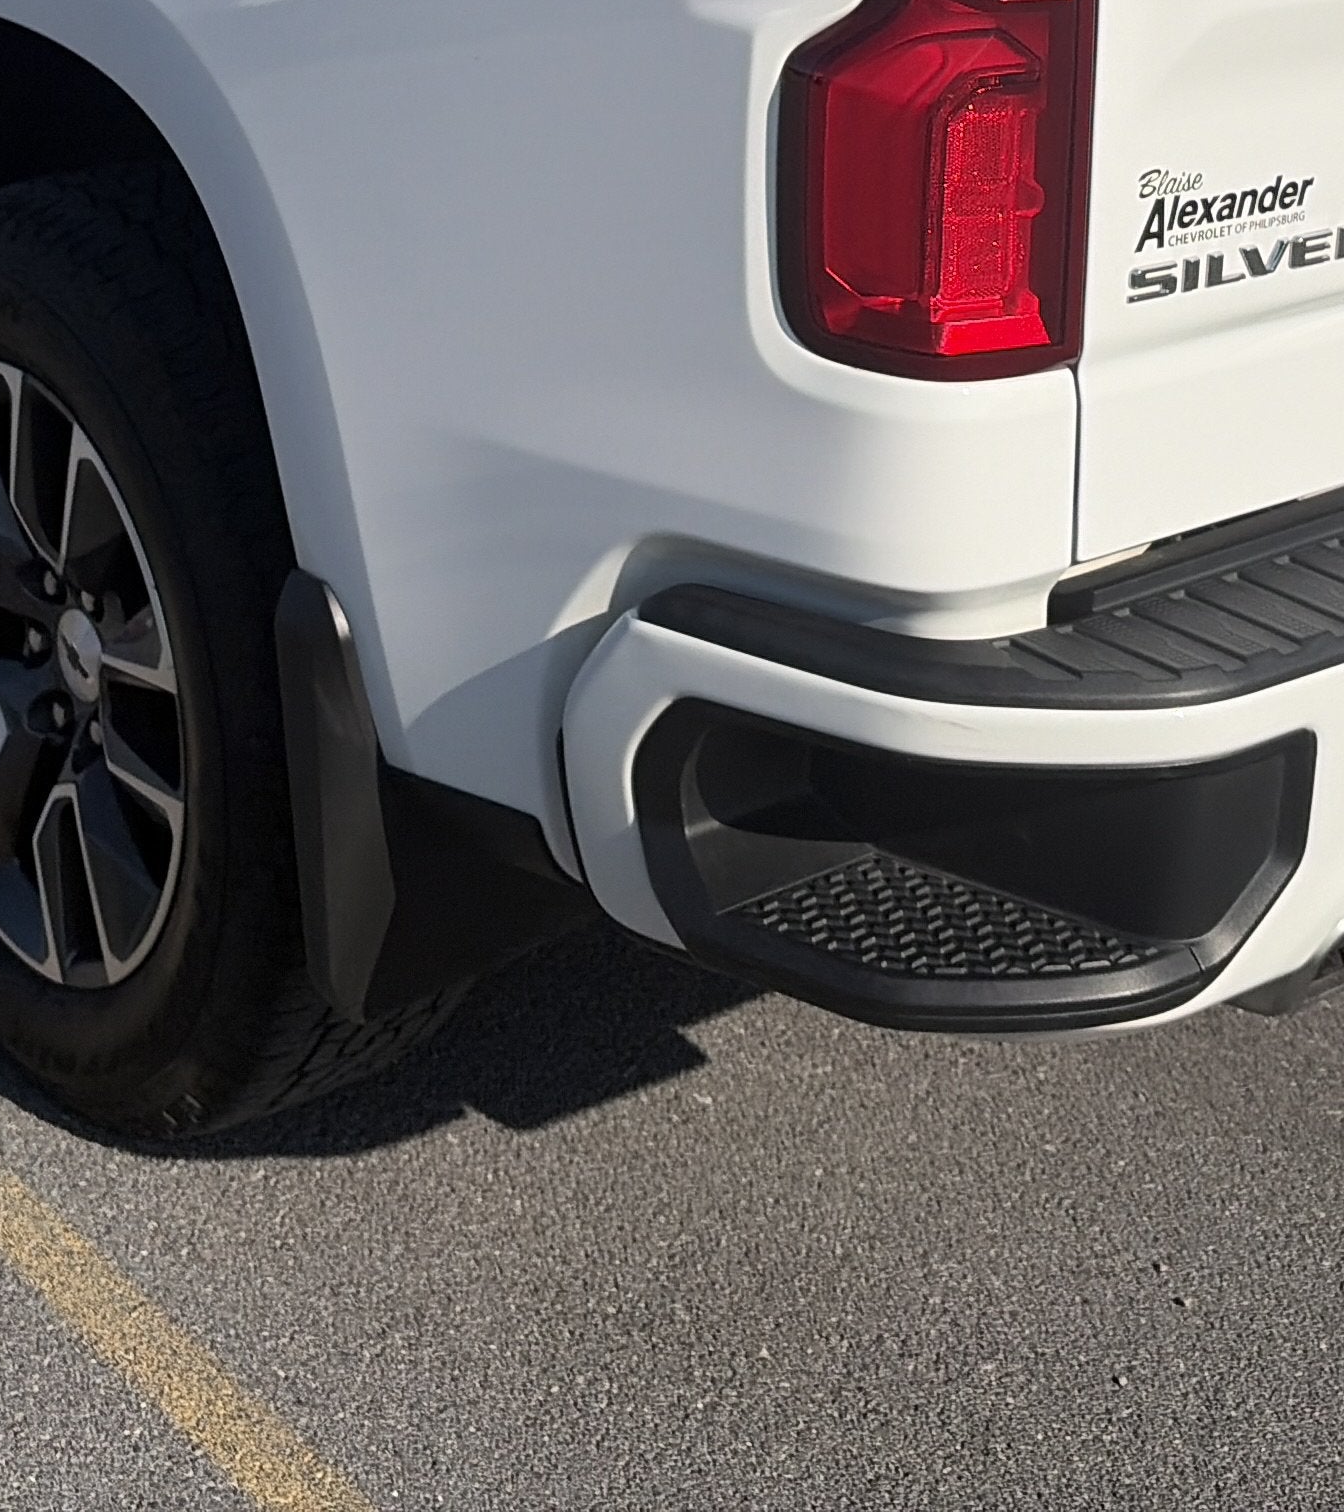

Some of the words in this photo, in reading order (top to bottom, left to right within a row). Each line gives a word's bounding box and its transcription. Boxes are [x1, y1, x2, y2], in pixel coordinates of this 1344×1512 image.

[1138, 169, 1203, 199] Blaise
[1134, 175, 1315, 253] Alexander
[1167, 224, 1233, 247] CHEVROLET
[1234, 222, 1249, 235] OF
[1249, 210, 1306, 231] PHILIPSBURG
